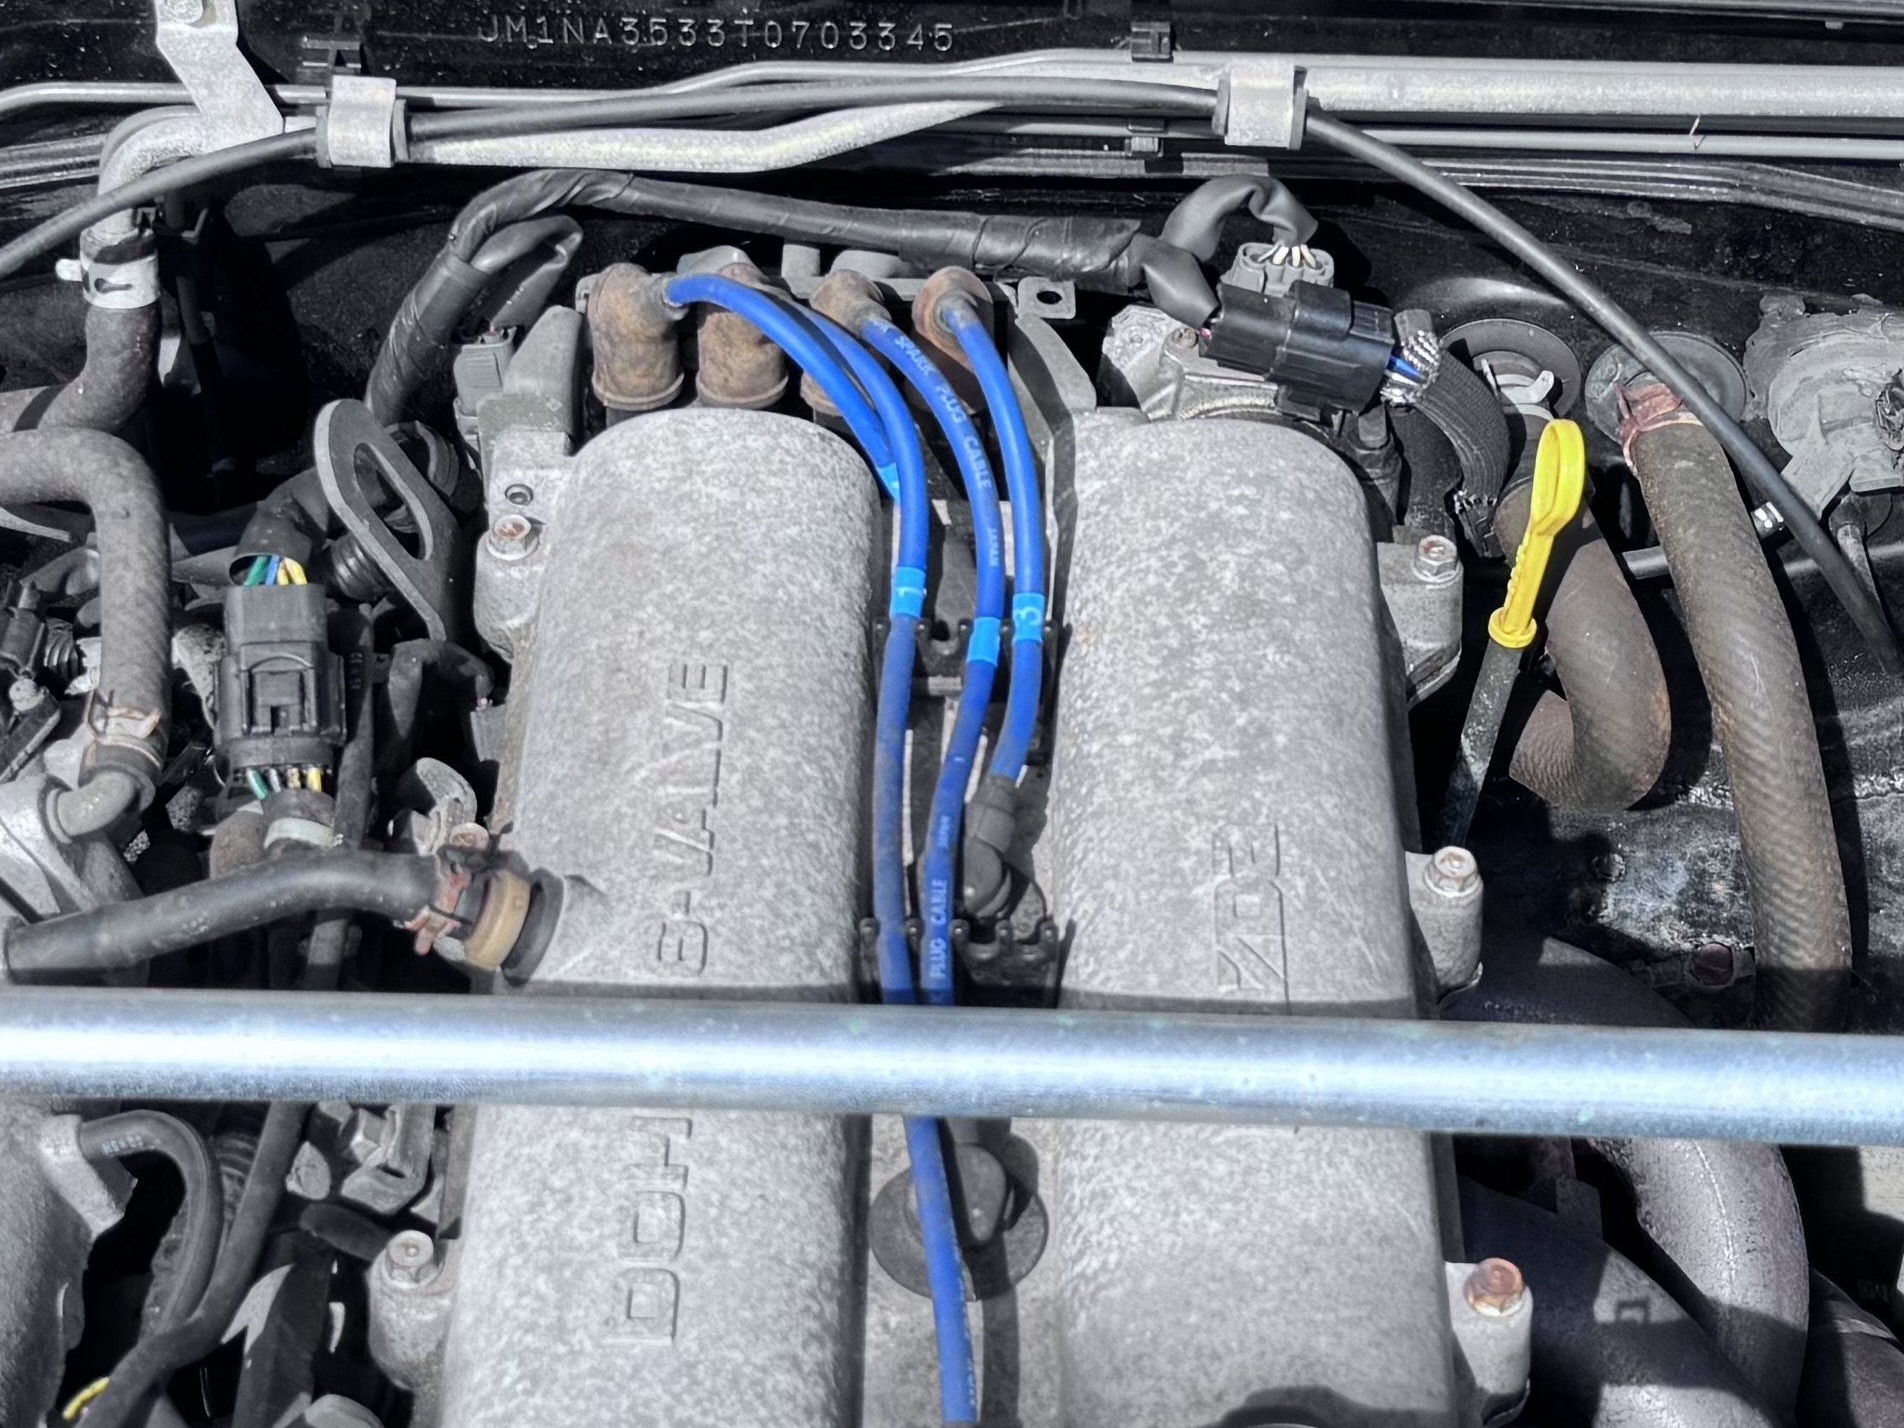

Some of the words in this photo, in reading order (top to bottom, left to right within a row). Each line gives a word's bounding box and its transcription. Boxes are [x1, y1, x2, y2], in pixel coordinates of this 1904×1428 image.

[963, 435, 992, 490] CABLE
[930, 878, 948, 926] CABLE
[929, 938, 947, 979] PLUG
